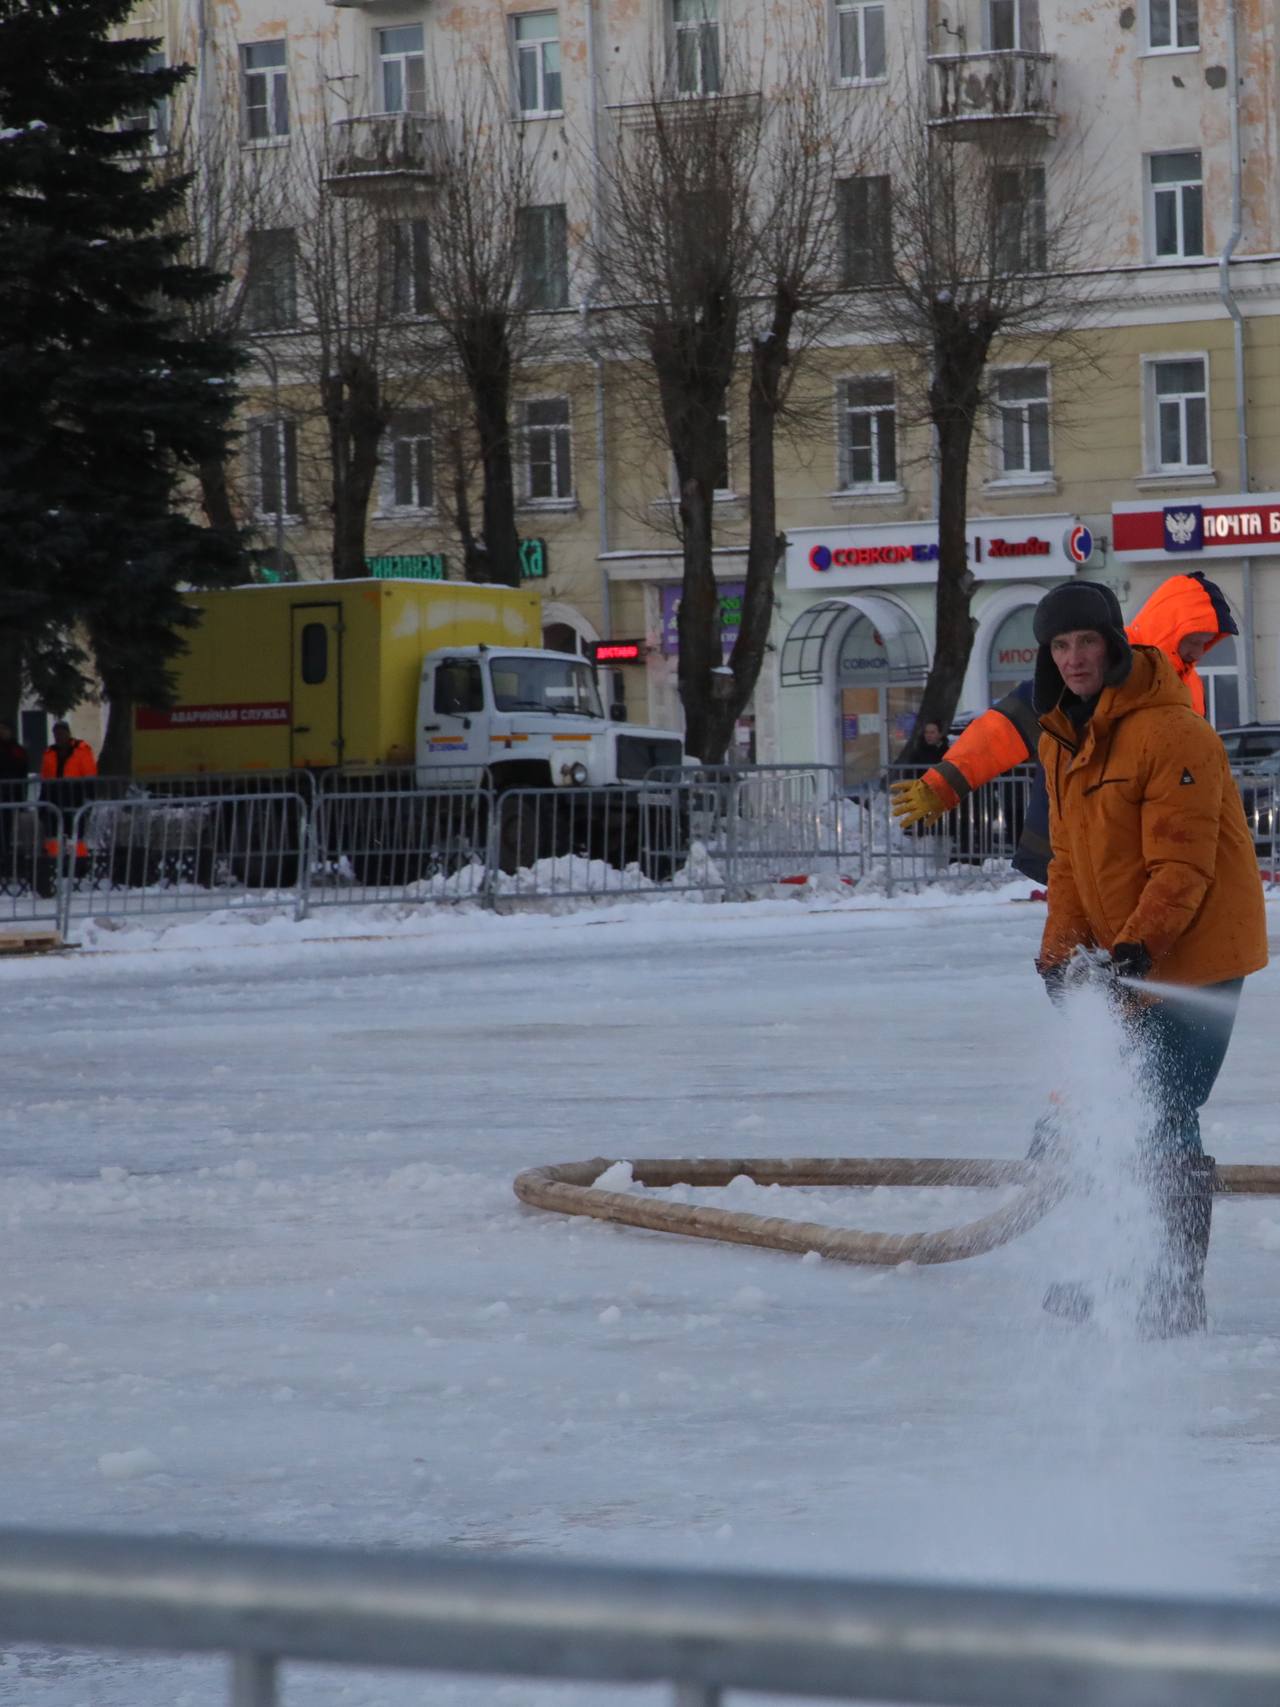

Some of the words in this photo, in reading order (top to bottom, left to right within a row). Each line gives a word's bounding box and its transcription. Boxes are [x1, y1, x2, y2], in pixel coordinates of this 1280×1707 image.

[1203, 513, 1263, 538] ПОЧТА
[831, 538, 968, 566] СОВКОМБА
[843, 656, 888, 670] СОВКОМ
[170, 708, 238, 722] АВАРИЙНАЯ
[240, 708, 287, 721] СЛУЖБА
